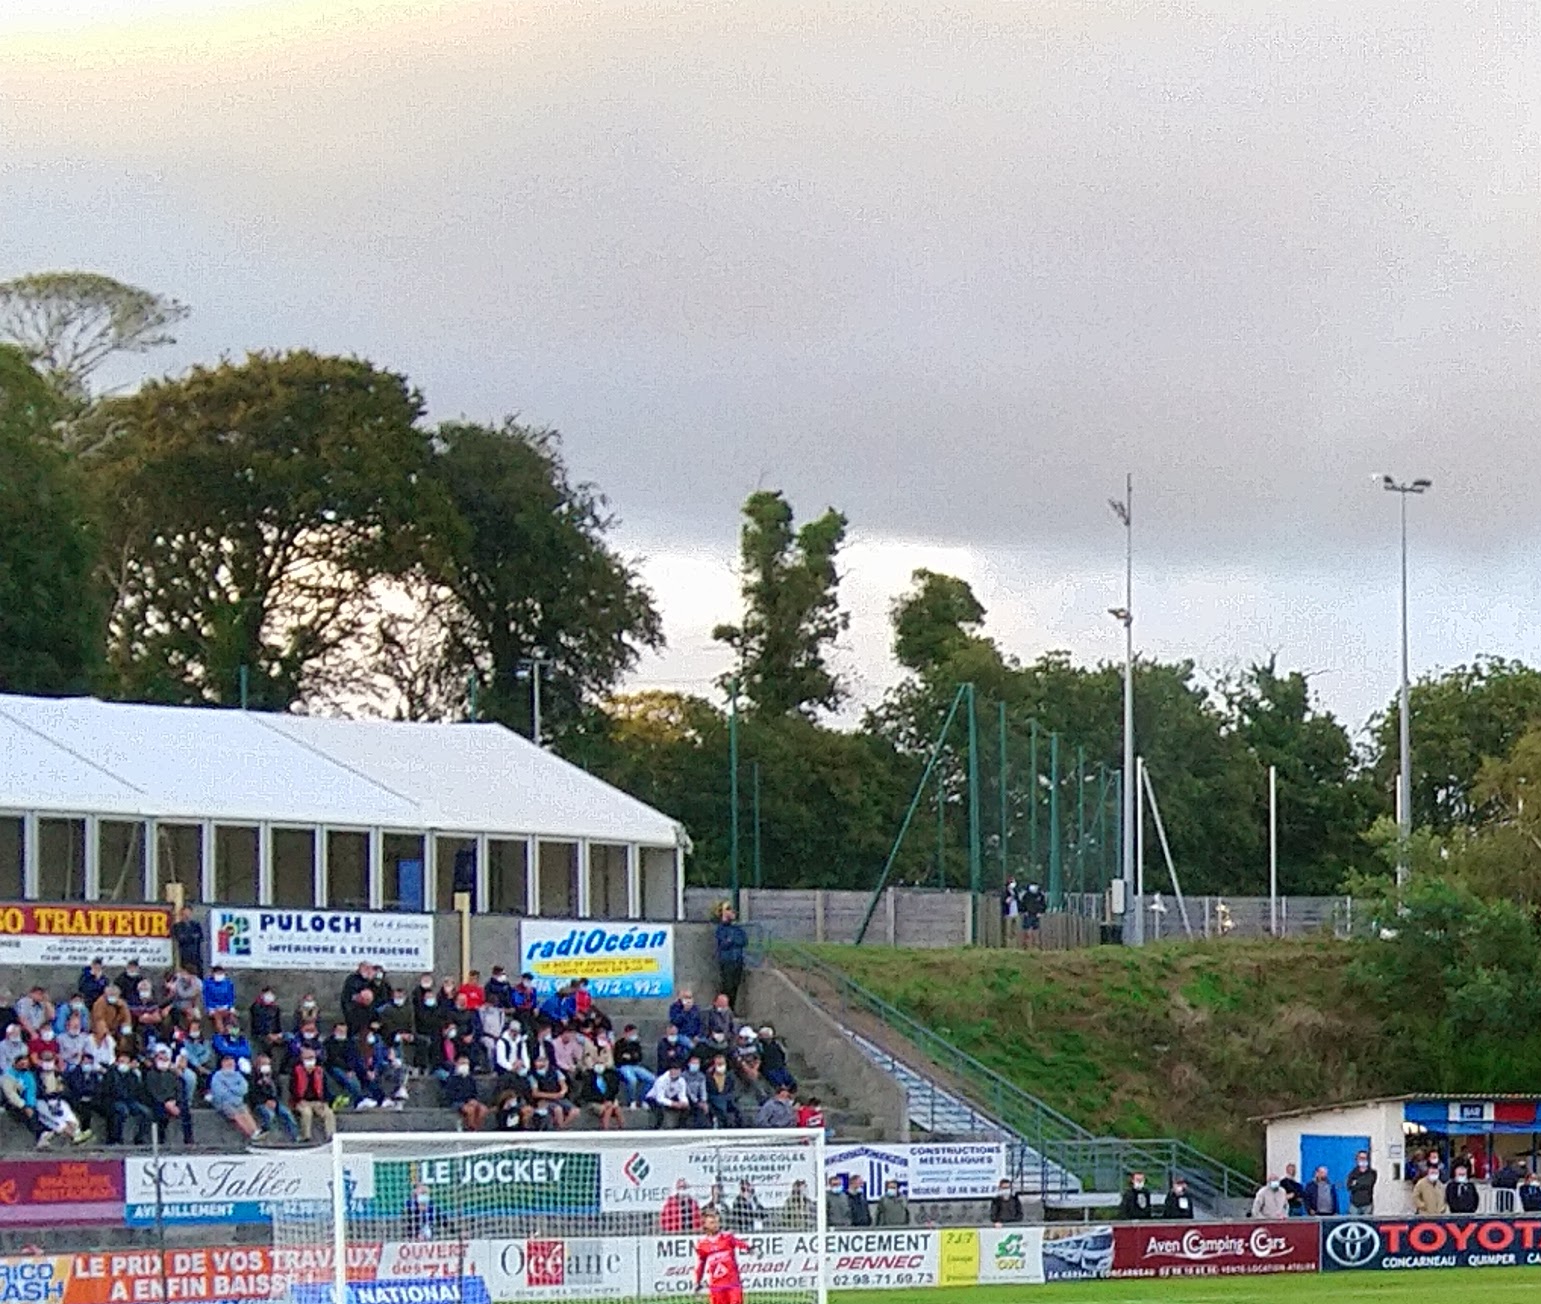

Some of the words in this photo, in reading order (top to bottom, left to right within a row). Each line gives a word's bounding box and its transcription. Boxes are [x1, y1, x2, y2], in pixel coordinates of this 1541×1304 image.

[34, 908, 170, 937] TRAITEUR
[260, 914, 361, 932] PULOCH
[527, 926, 667, 960] radiOcéan
[142, 1160, 198, 1188] SCA
[422, 1160, 450, 1183] LE
[461, 1158, 567, 1183] JOCKEY
[1147, 1236, 1181, 1253] Aven
[75, 1255, 106, 1279] LE
[173, 1252, 207, 1274] DE
[212, 1250, 263, 1273] VOS
[501, 1243, 622, 1277] Océane
[835, 1254, 925, 1271] PENNEC
[1382, 1256, 1456, 1269] CONCARNEAU
[1468, 1254, 1516, 1266] QUIMPER
[111, 1280, 130, 1301] A
